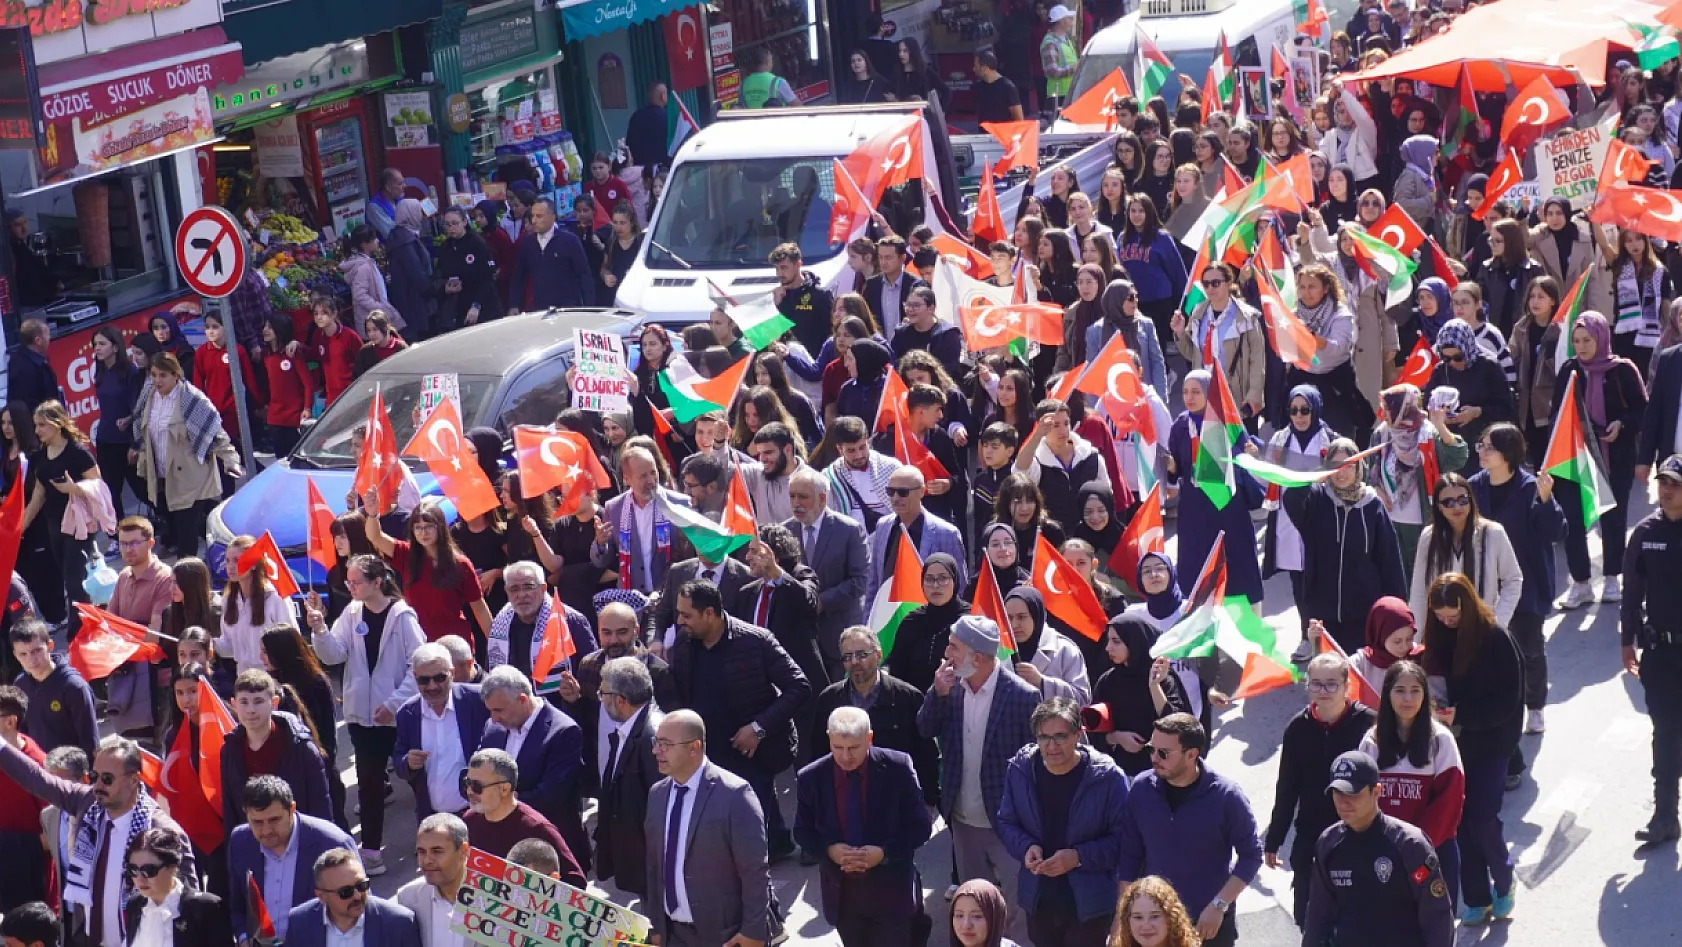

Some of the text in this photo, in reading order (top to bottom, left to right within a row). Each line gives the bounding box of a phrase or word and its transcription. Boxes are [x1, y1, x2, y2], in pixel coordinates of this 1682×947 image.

[43, 92, 93, 119] GÖZDE
[108, 77, 154, 104] SUCUK
[166, 63, 213, 89] DÖNER
[1398, 783, 1423, 800] YORK
[457, 886, 563, 943] GAZZE'DE
[463, 869, 562, 922] KORKMA
[505, 866, 632, 929] ÖLMEKTEN
